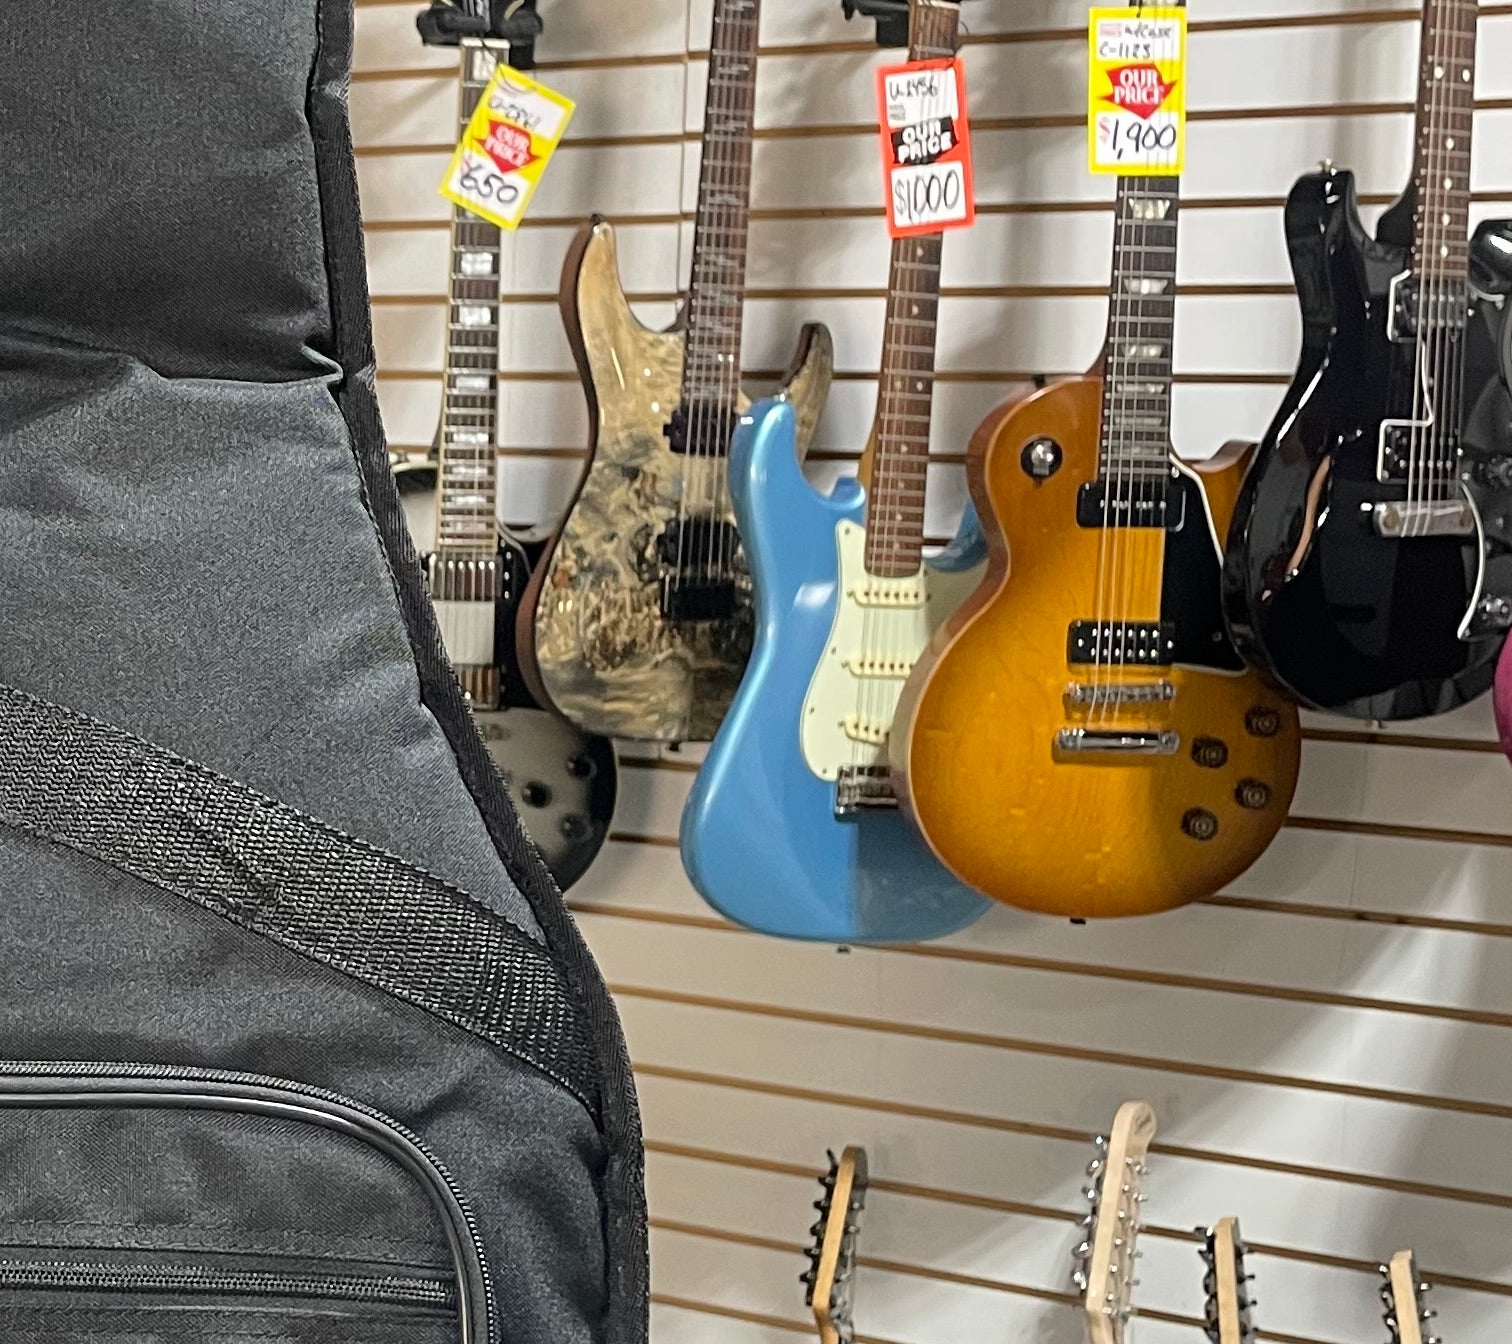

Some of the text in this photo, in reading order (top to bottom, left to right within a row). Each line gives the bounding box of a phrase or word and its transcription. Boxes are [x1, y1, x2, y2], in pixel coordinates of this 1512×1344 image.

[1119, 68, 1159, 87] OUR
[1114, 85, 1165, 106] PRICE
[901, 120, 941, 145] OUR
[1099, 116, 1177, 160] $1,900
[897, 131, 953, 165] PRICE
[895, 168, 960, 224] $1000
